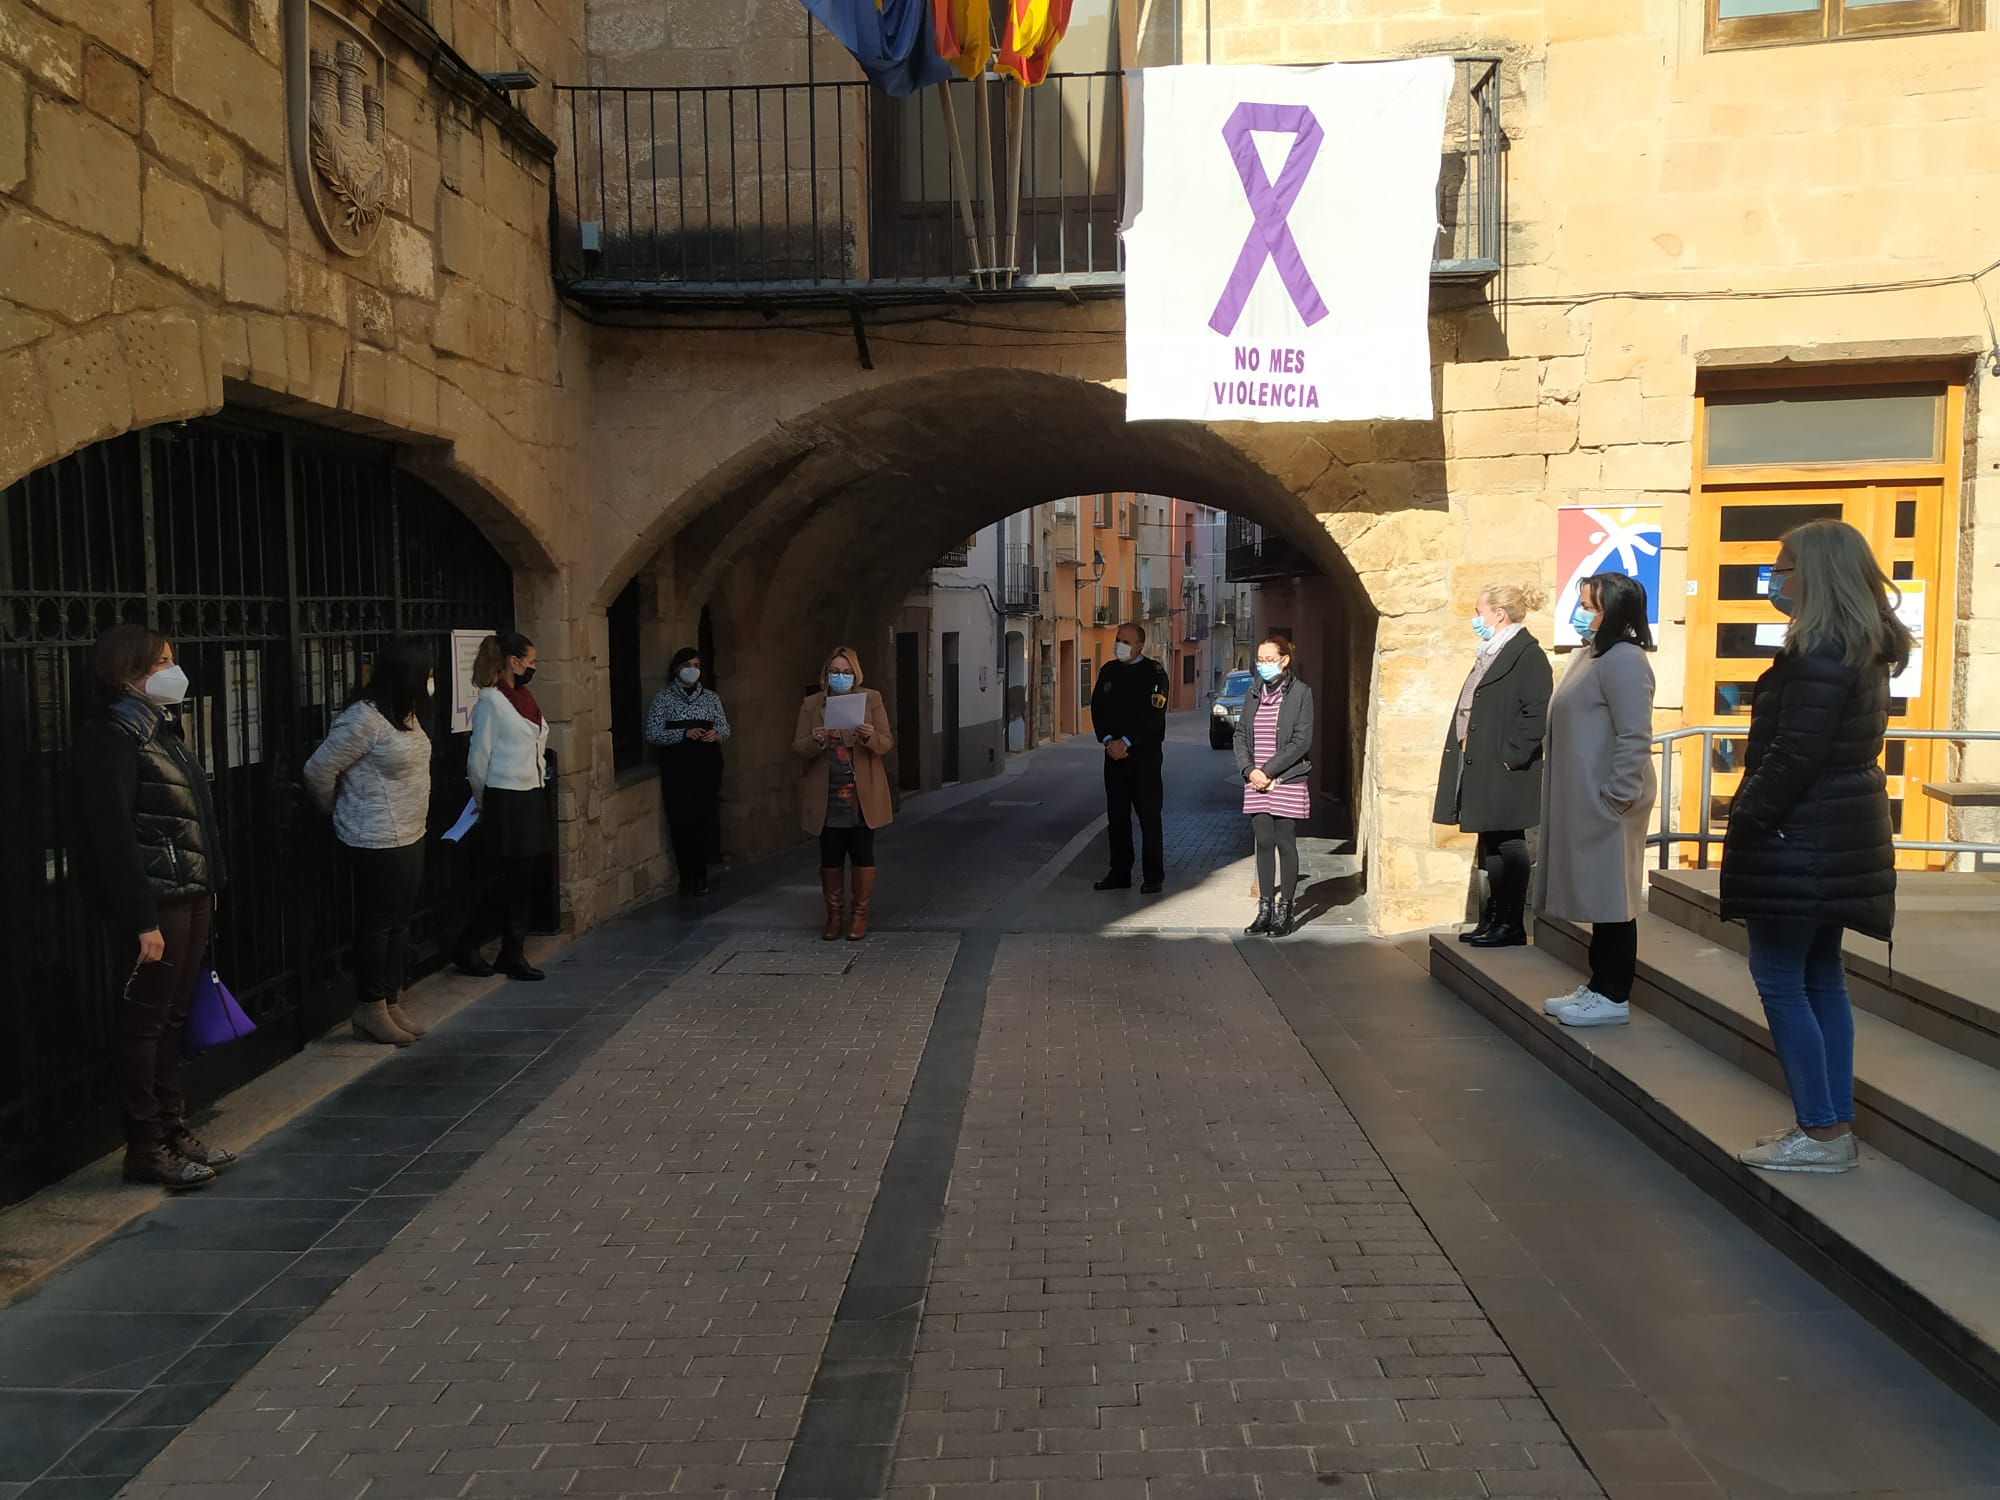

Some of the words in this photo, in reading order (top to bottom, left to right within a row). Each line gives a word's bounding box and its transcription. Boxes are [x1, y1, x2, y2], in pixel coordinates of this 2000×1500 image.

[1235, 346, 1260, 371] NO
[1269, 348, 1305, 373] MES
[1213, 381, 1319, 408] VIOLENCIA
